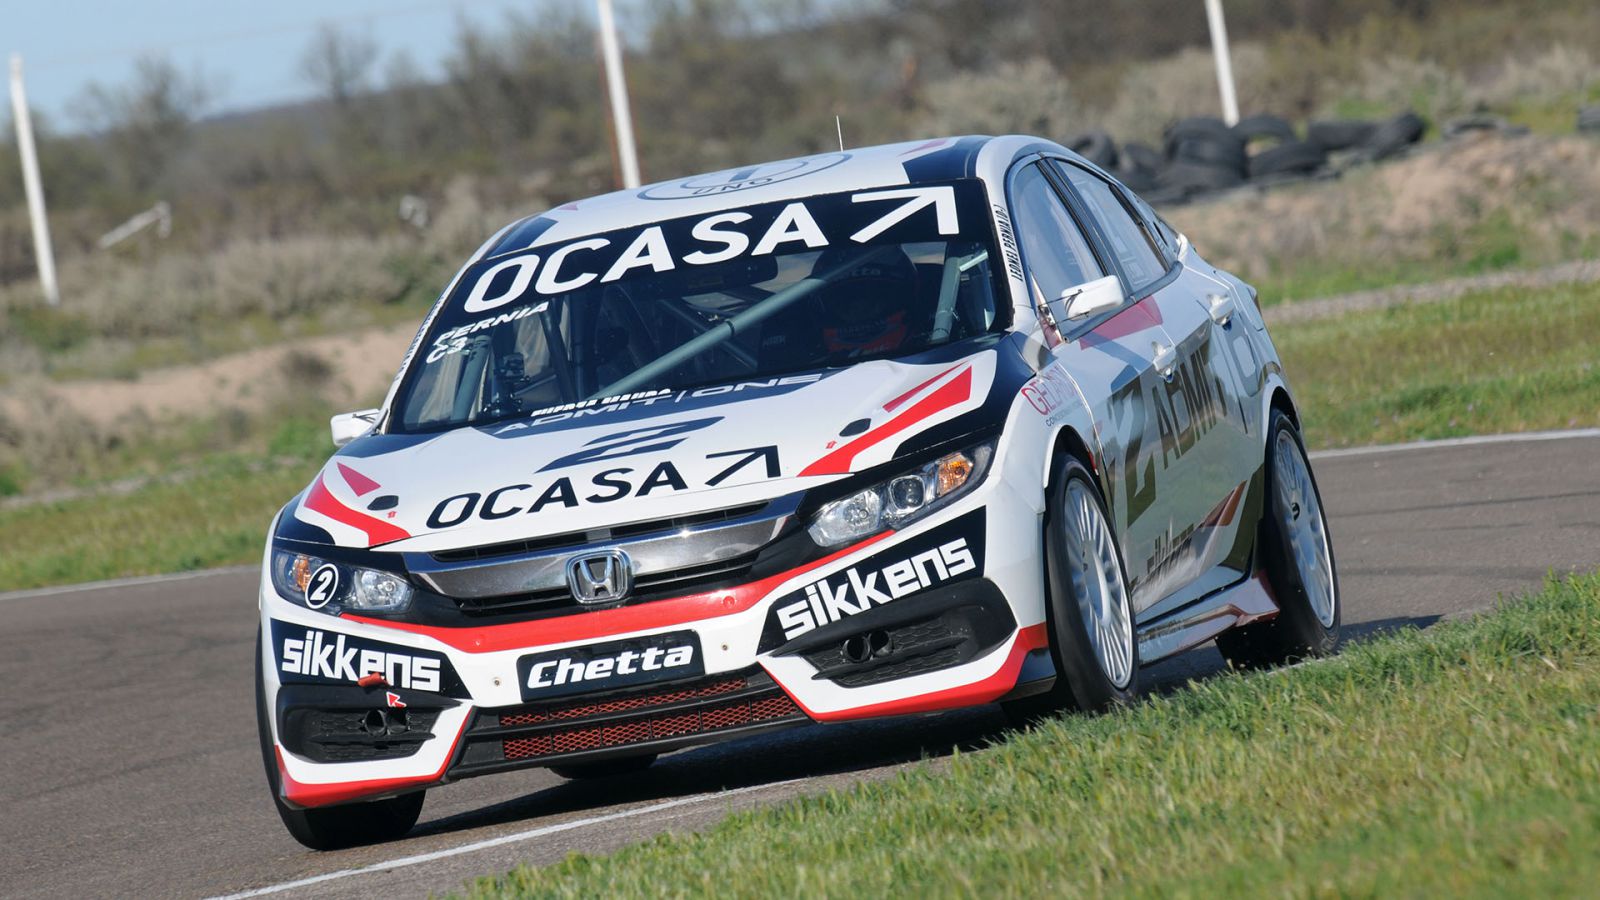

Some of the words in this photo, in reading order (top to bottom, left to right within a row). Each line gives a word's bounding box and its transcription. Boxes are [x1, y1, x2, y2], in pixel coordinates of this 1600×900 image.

[692, 177, 773, 195] UNO
[464, 201, 829, 314] OCASA
[432, 301, 550, 347] PERNIA
[691, 373, 823, 398] ONE
[426, 461, 688, 529] OCASA
[309, 570, 333, 601] 2
[777, 537, 977, 641] sikkens
[281, 630, 441, 692] sikkens
[527, 645, 694, 689] Chetta
